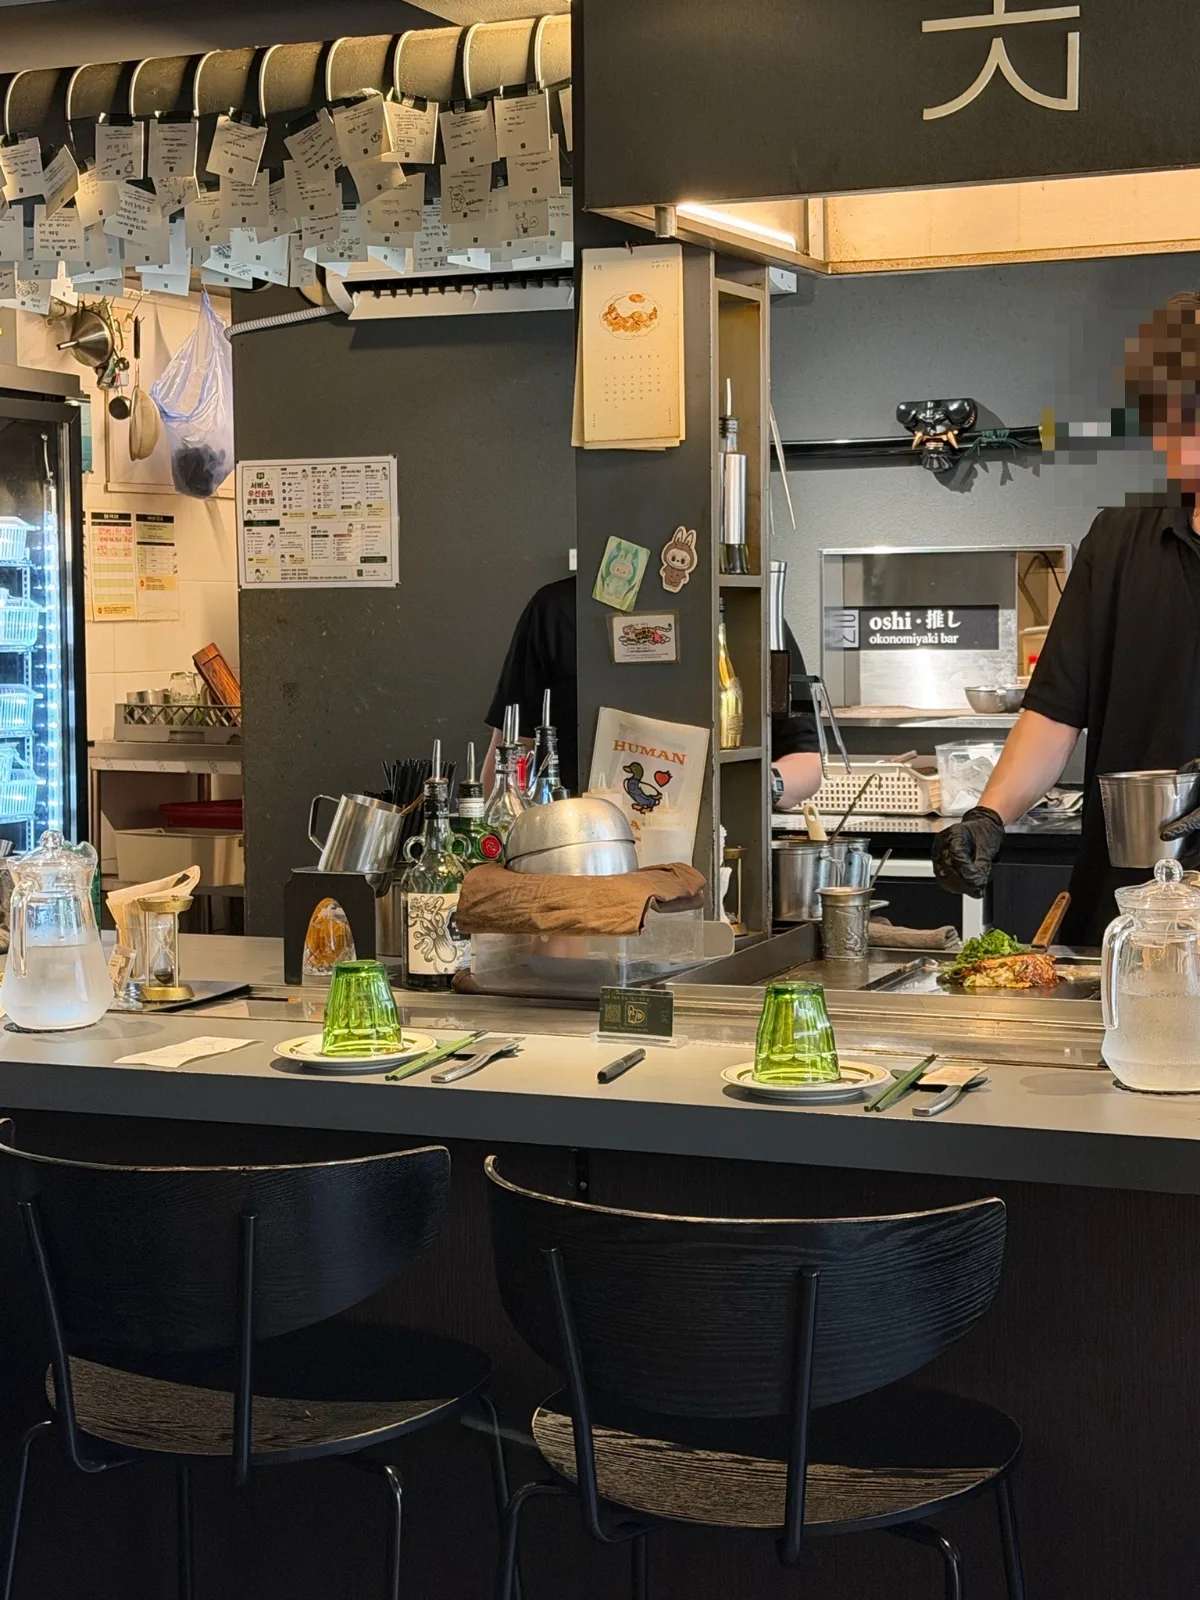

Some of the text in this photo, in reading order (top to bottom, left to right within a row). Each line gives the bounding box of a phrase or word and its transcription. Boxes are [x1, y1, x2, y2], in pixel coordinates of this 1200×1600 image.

[869, 610, 912, 630] oshi
[926, 610, 961, 629] 推し
[869, 633, 959, 646] okonomiyaki bar
[613, 740, 687, 765] HUMAN
